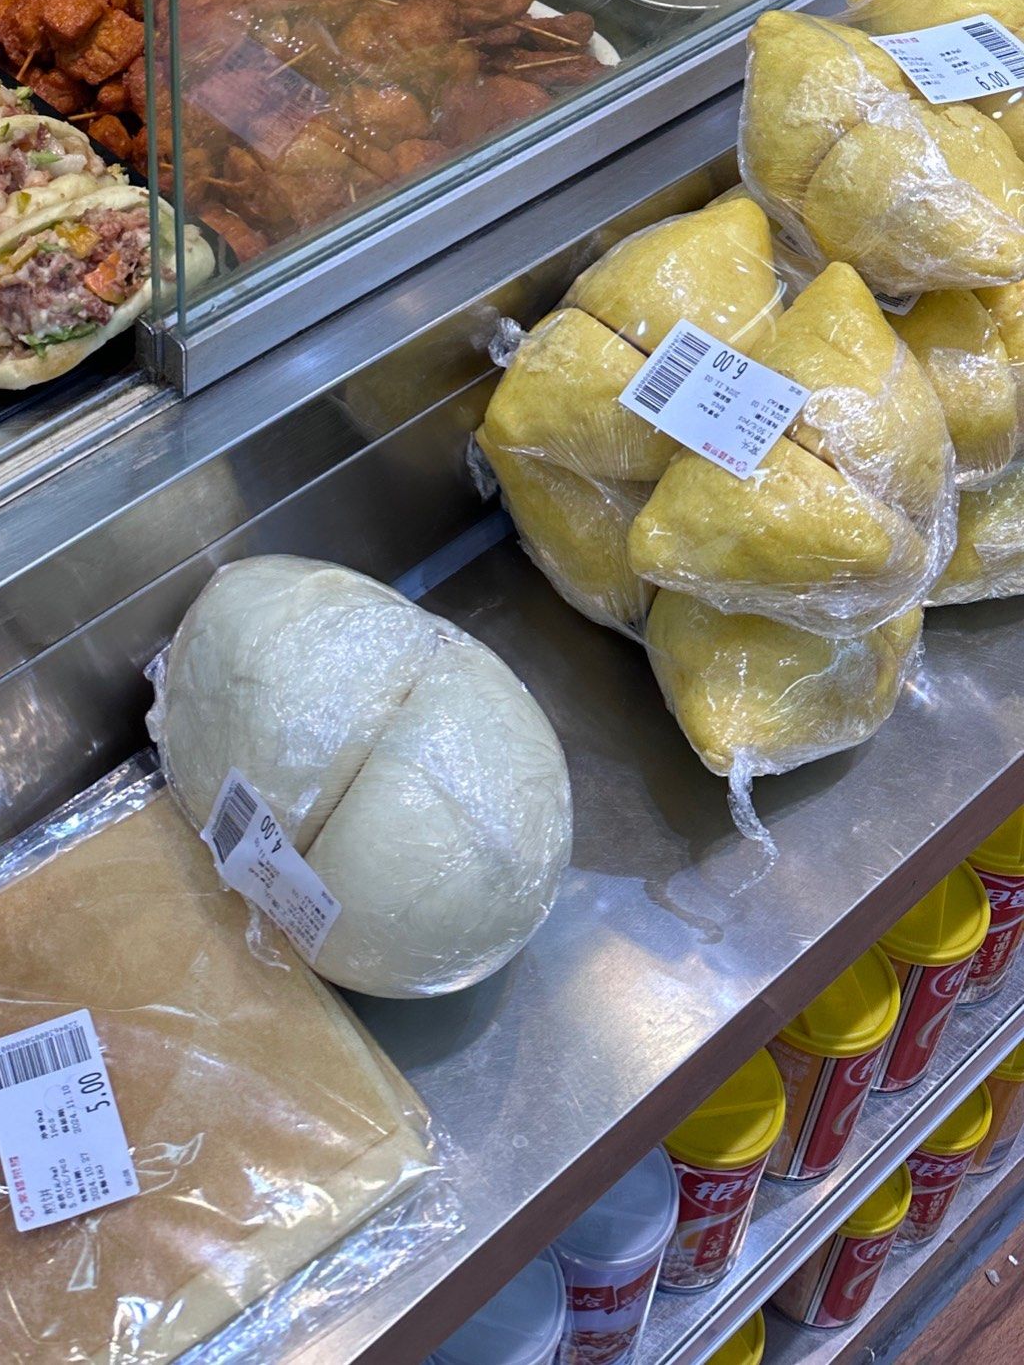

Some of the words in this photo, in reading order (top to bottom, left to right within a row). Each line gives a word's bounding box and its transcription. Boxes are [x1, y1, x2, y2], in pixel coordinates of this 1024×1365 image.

[975, 70, 1010, 91] 6.00
[711, 350, 747, 379] 6.00
[738, 438, 761, 456] 窝头
[260, 815, 282, 853] 4.00
[78, 1071, 108, 1111] 5.00
[62, 1084, 81, 1133] 2024.11.10
[80, 1151, 99, 1201] 2024.10.27
[38, 1187, 56, 1215] 煎饼
